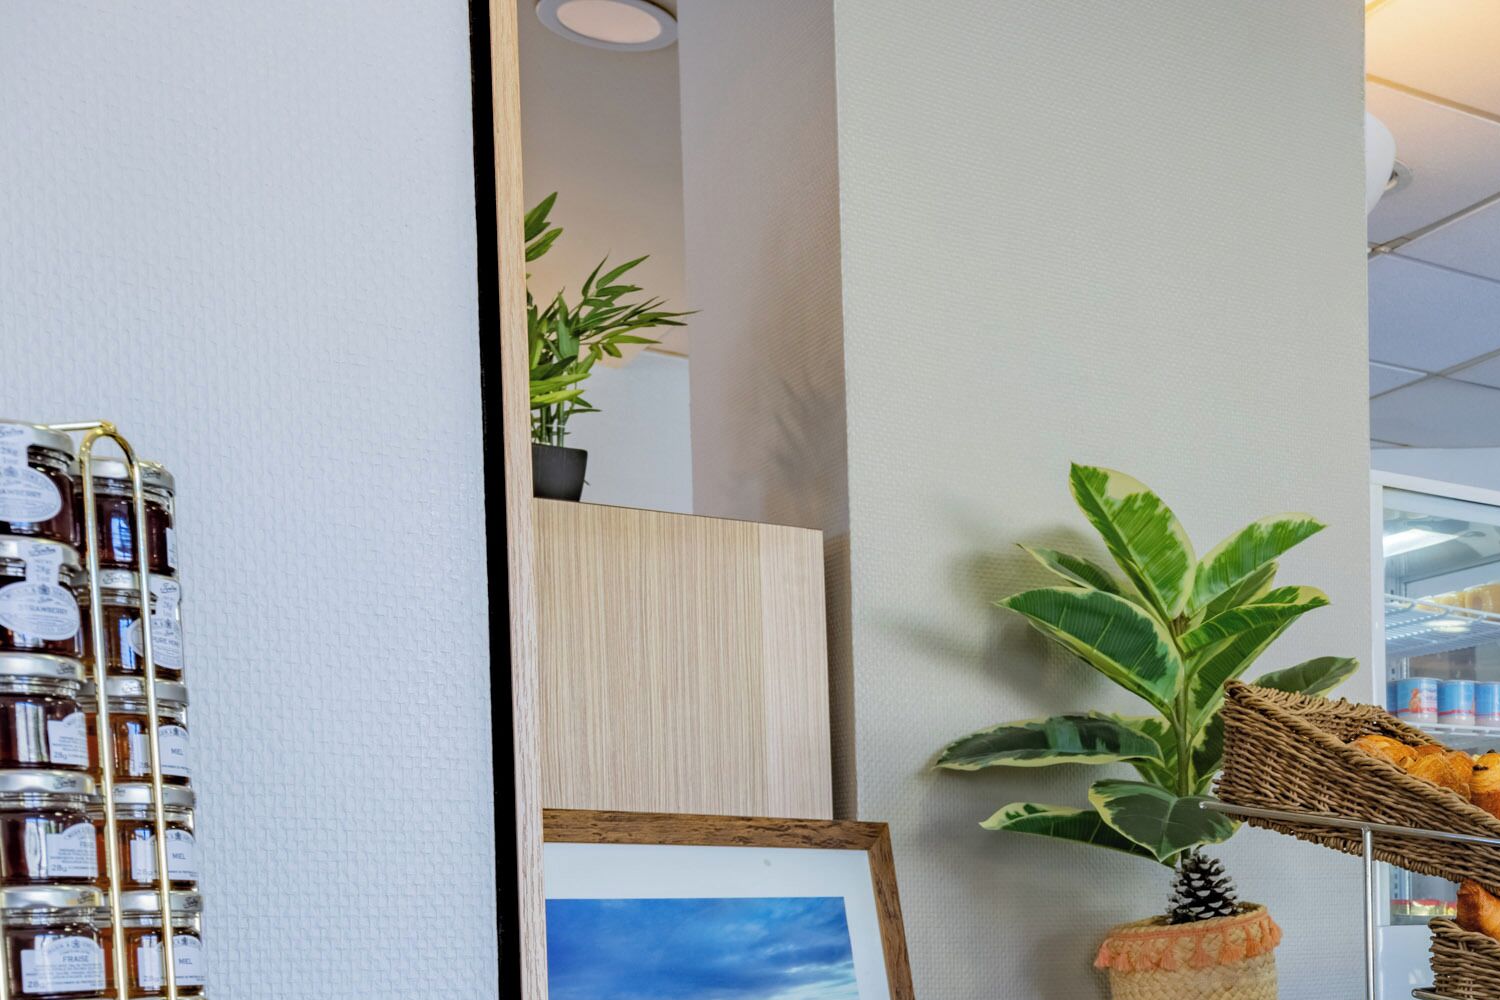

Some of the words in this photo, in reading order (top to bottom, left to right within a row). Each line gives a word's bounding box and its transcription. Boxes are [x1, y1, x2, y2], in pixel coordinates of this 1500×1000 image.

[172, 852, 187, 860] MIEL
[62, 954, 89, 964] FRAISE
[178, 957, 193, 965] MIEL
